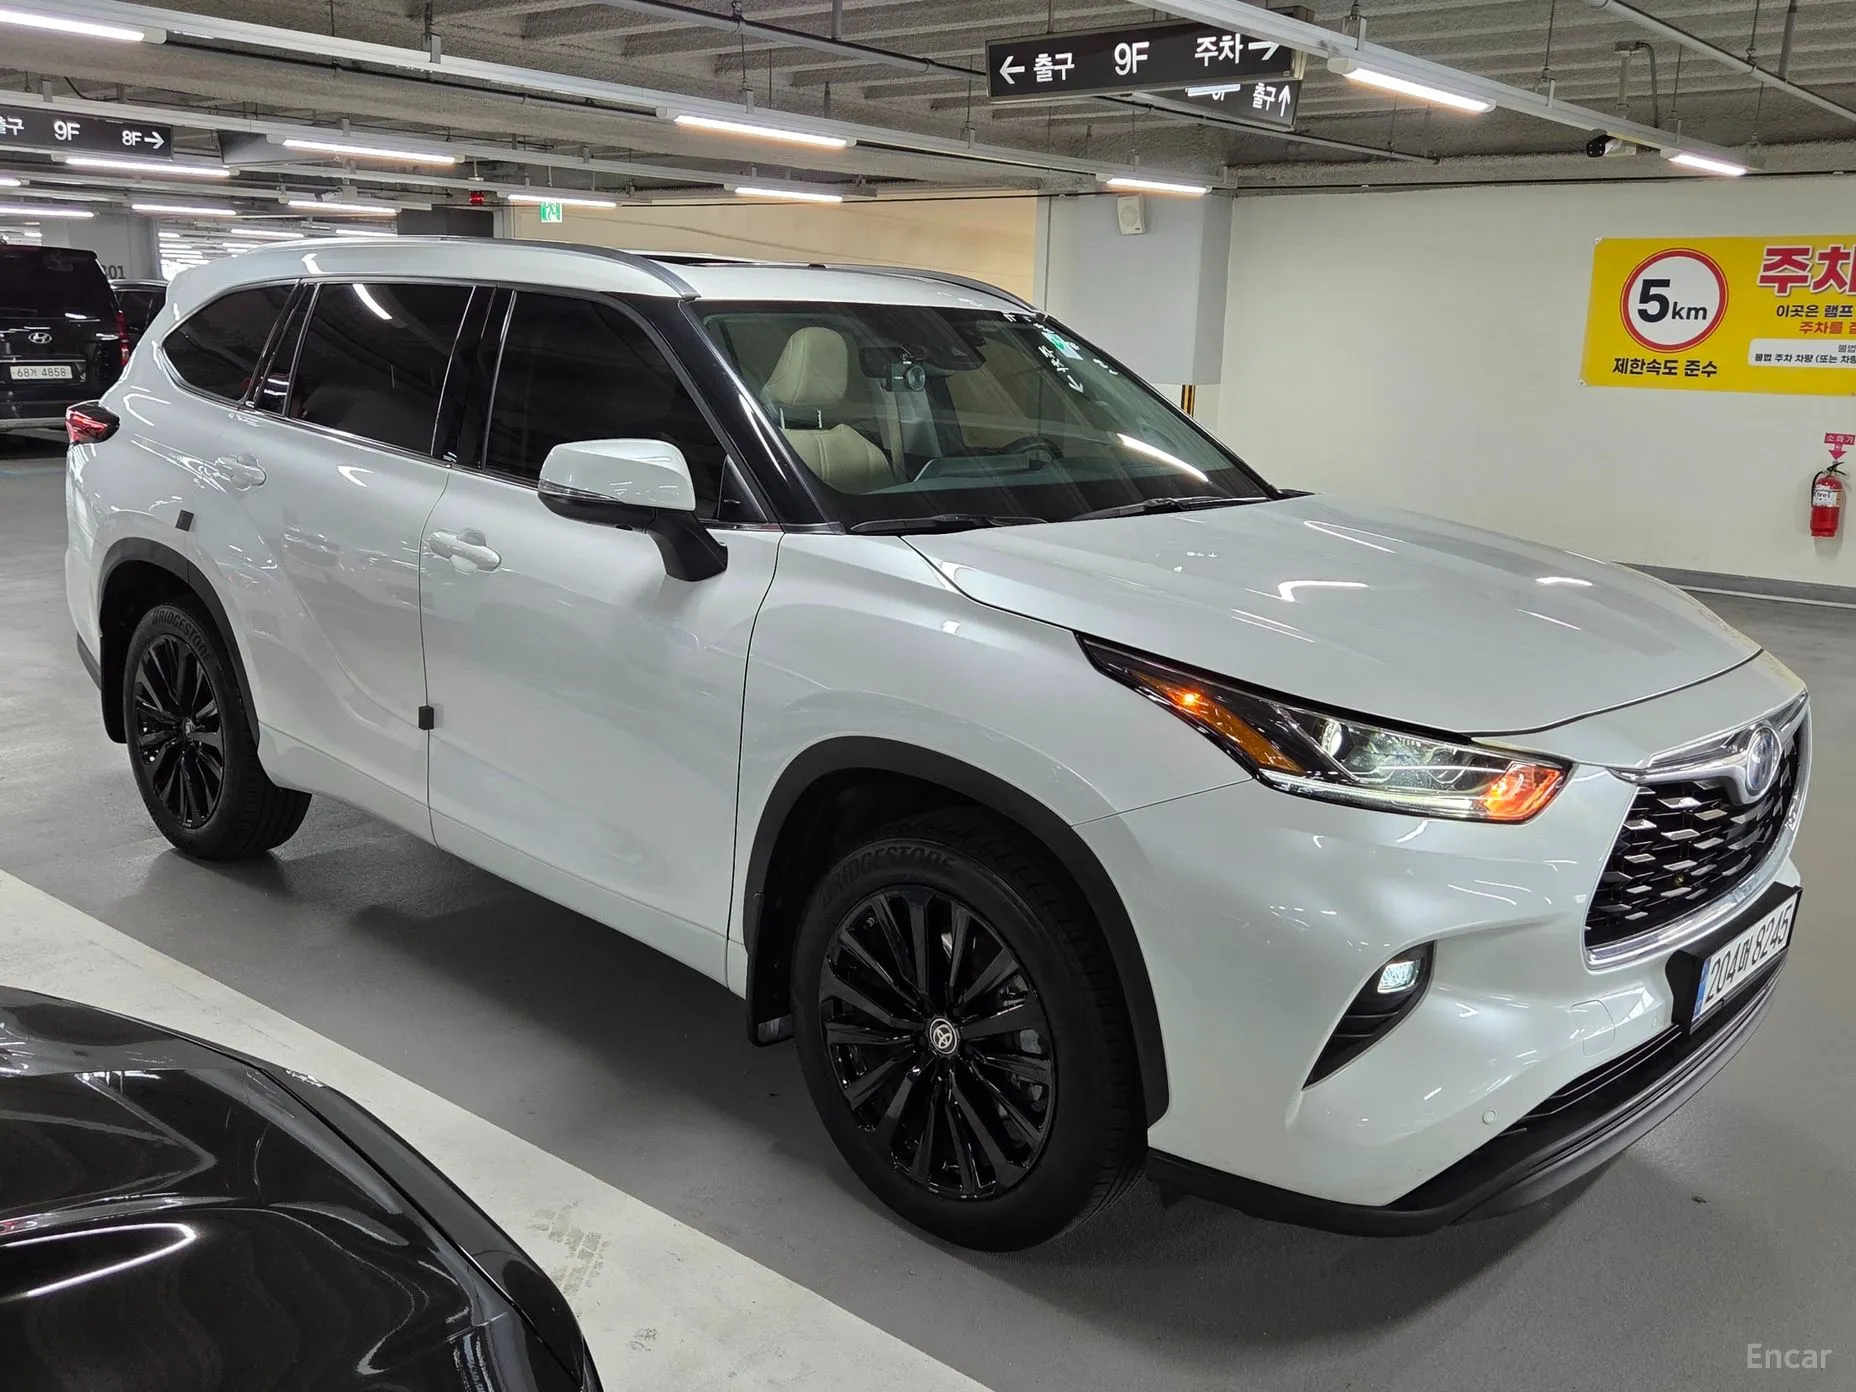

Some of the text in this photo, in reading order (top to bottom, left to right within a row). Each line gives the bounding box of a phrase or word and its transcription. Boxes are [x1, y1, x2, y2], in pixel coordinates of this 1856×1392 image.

[1033, 33, 1244, 82] 출구 9F 주차
[1253, 82, 1277, 111] 출구
[54, 120, 81, 141] 9F
[121, 130, 142, 146] 8F
[1776, 305, 1854, 318] 이곳은 램프
[1799, 321, 1843, 335] 주차를
[1755, 353, 1772, 362] 불법
[1775, 353, 1792, 362] 주차
[1795, 354, 1814, 362] 차량
[41, 367, 67, 377] 4858
[1612, 358, 1718, 378] 제한속도 준수
[1751, 904, 1793, 966] 8245
